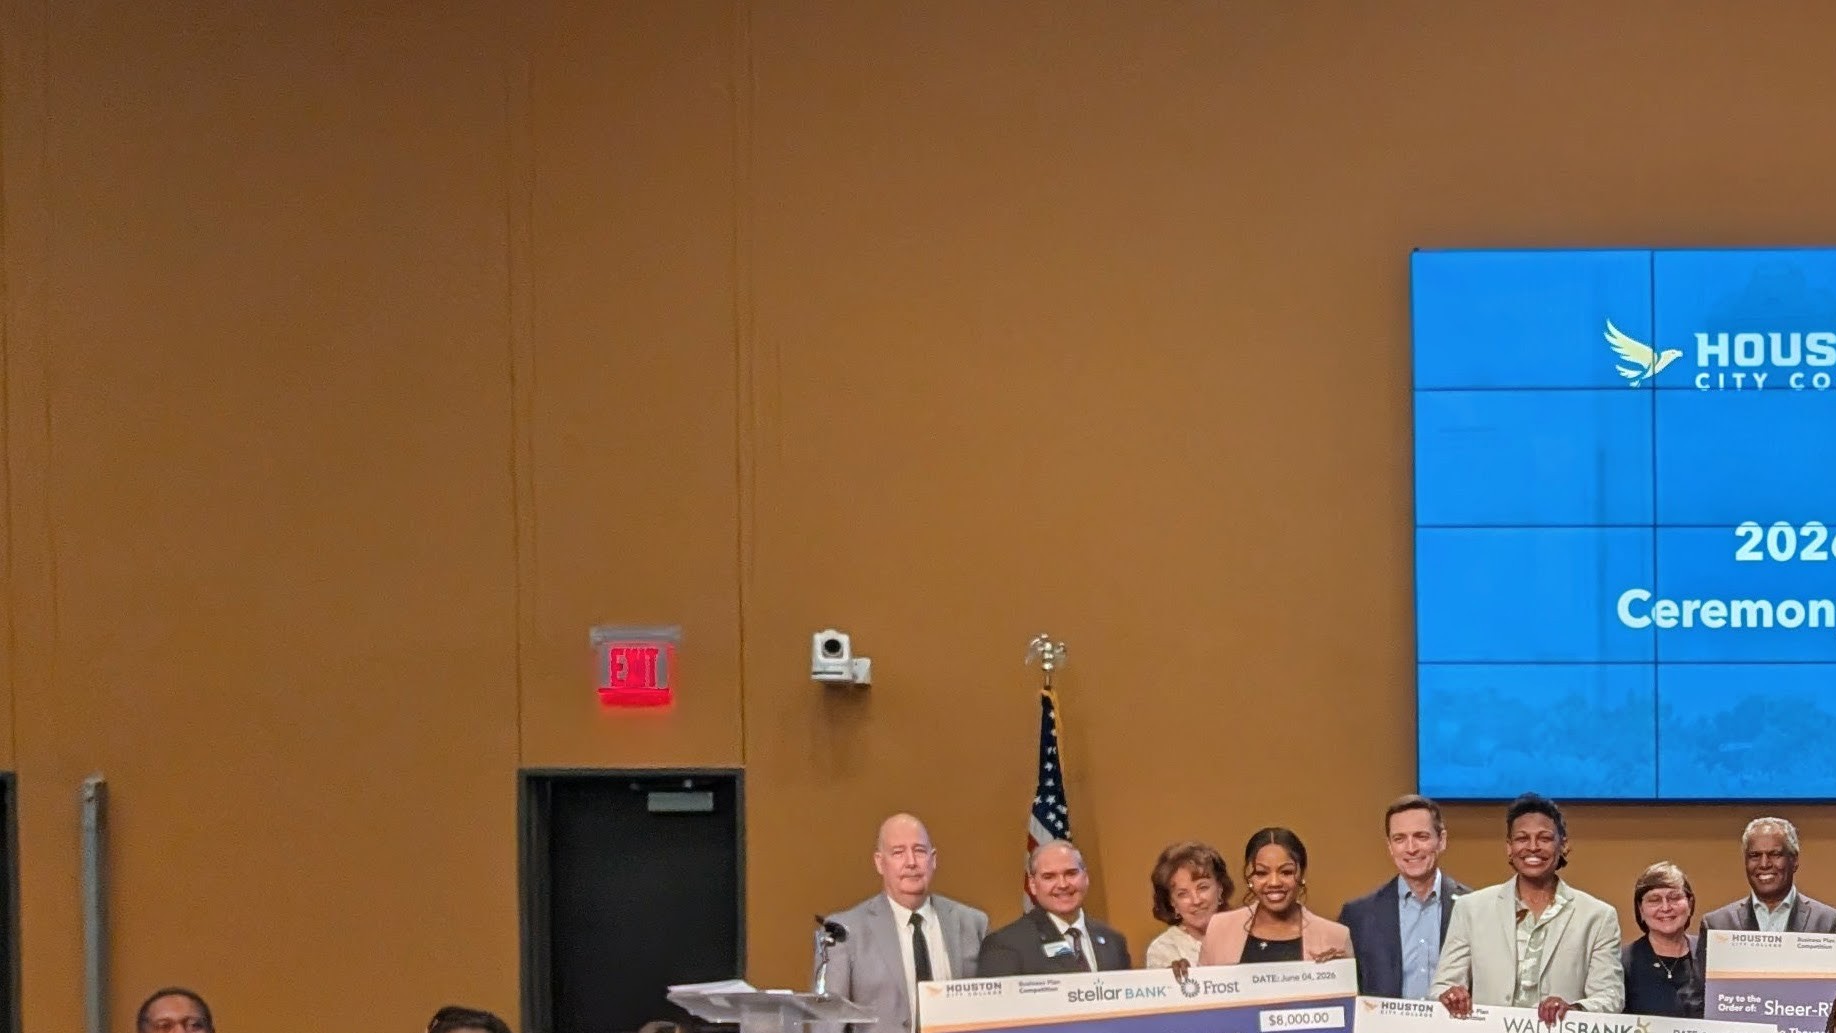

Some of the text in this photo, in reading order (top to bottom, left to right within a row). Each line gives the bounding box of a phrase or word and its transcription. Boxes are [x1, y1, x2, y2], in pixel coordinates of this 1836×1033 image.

[1695, 372, 1768, 391] CITY
[1253, 972, 1336, 983] DATE: June 04, 2026
[1067, 986, 1166, 1002] stellar BANK
[1204, 981, 1239, 994] Frost
[1269, 1012, 1328, 1026] $8,000.00
